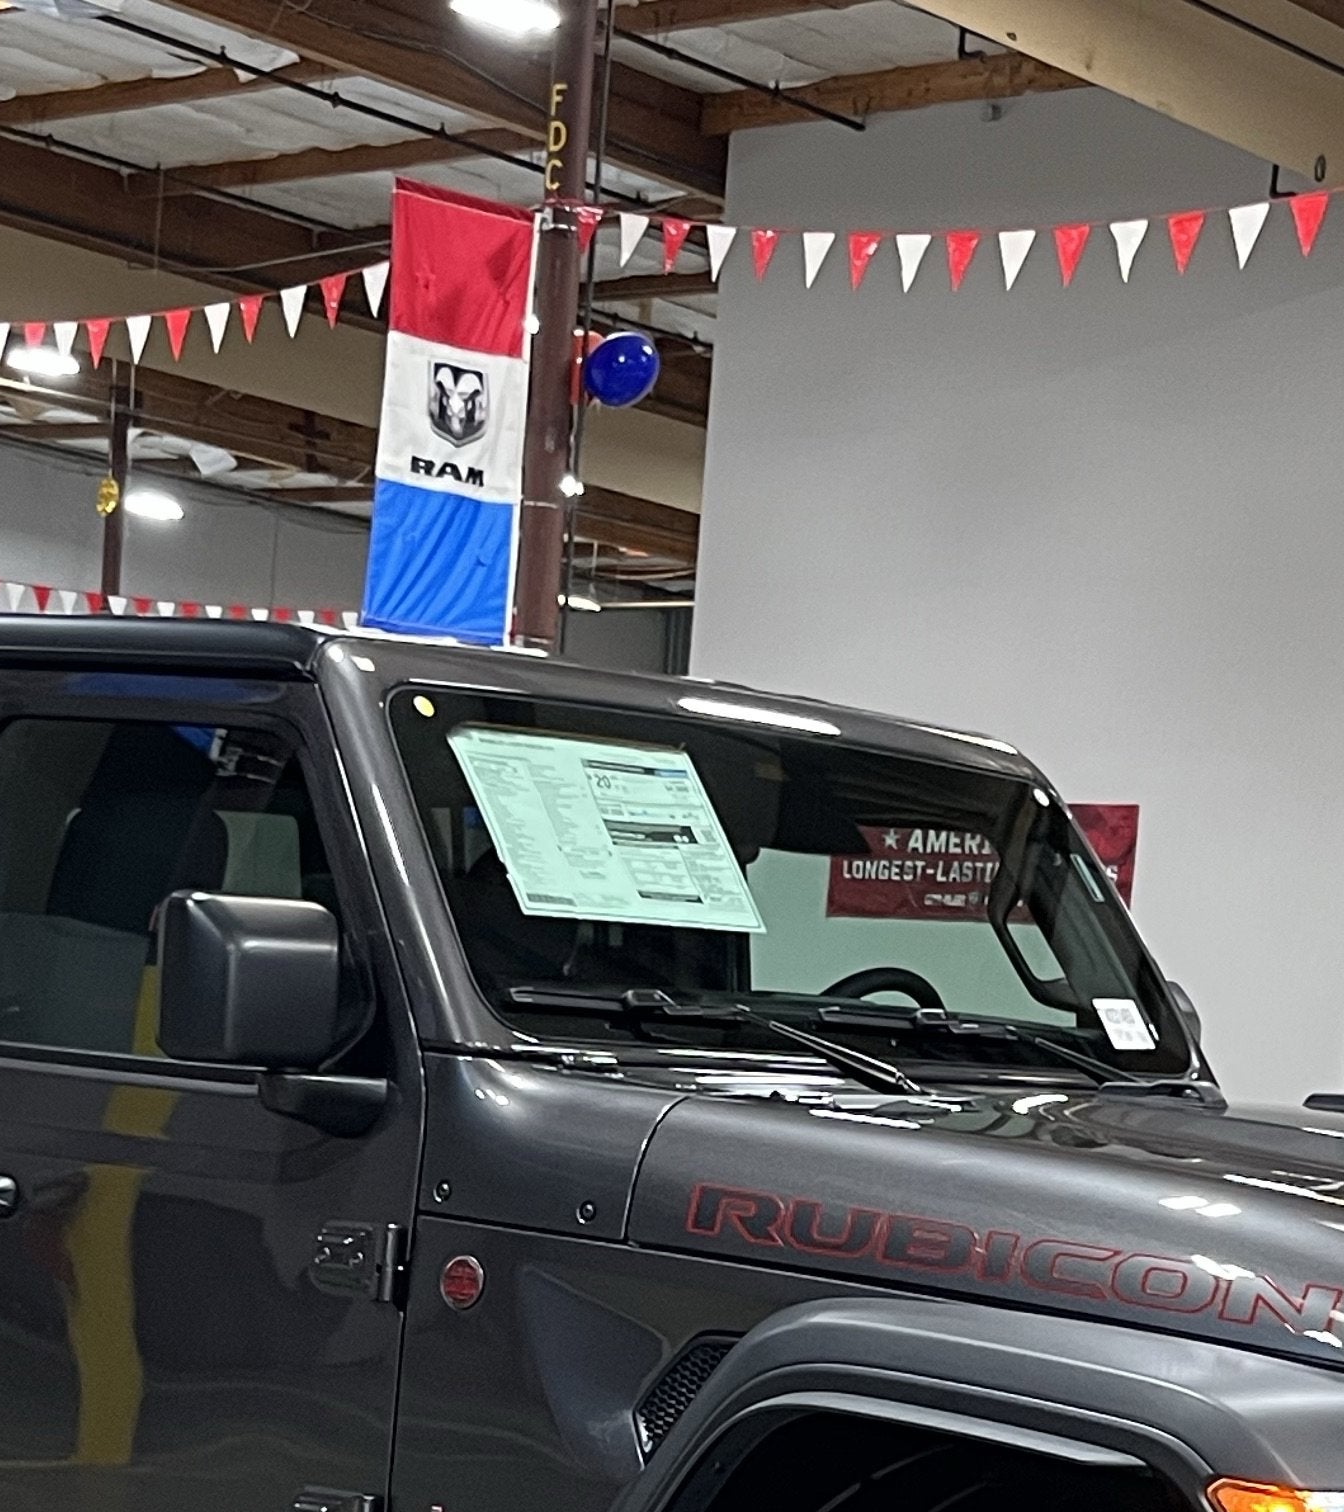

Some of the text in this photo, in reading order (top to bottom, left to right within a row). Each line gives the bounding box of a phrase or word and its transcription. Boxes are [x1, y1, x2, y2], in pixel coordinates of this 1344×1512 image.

[546, 83, 568, 190] FDC
[410, 455, 484, 488] RAM
[685, 1182, 1344, 1348] RUBICON
